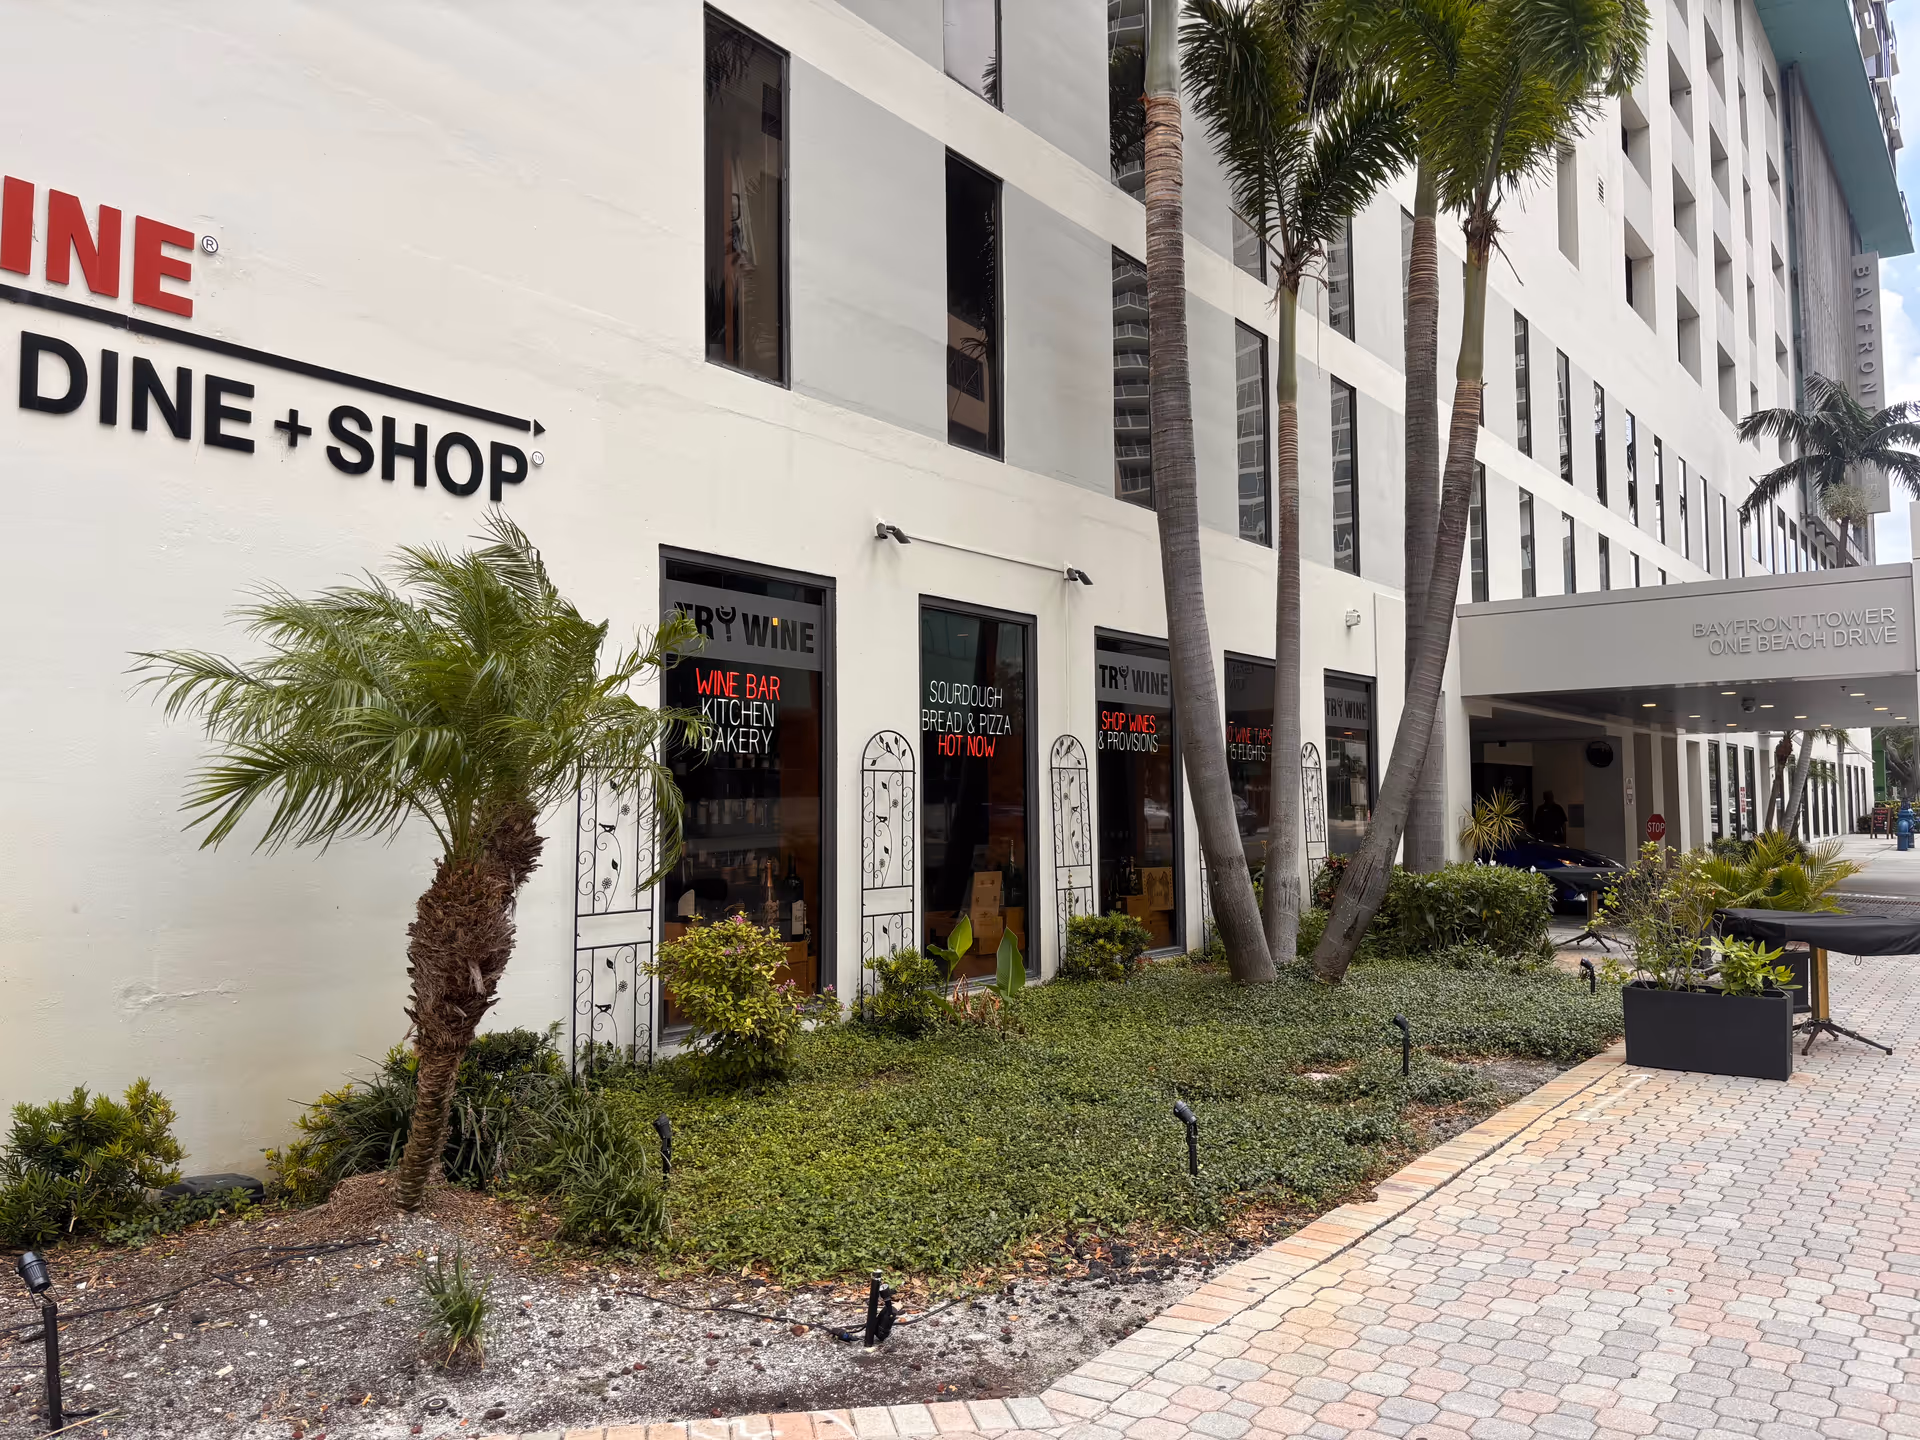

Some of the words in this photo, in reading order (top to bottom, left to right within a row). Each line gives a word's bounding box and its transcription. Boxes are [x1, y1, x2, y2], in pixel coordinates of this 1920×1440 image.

[19, 331, 255, 453] DINE
[326, 405, 528, 502] SHOP
[741, 612, 814, 654] WINE
[1692, 615, 1806, 637] BAYFRONT
[1811, 607, 1896, 629] TOWER
[1709, 636, 1751, 655] ONE
[1757, 632, 1827, 652] BEACH
[1833, 625, 1898, 647] DRIVE
[696, 668, 740, 697] WINE
[746, 672, 781, 700] BAR
[1098, 663, 1129, 691] TRY
[1131, 669, 1169, 696] WINE
[929, 680, 1003, 708] SOURDOUGH
[701, 697, 775, 728] KITCHEN
[922, 709, 963, 733] BREAD
[966, 712, 976, 734] &
[979, 713, 1012, 735] PIZZA
[1102, 710, 1126, 731] SHOP
[1128, 713, 1156, 734] WINES
[1344, 700, 1367, 720] WINE
[701, 725, 774, 754] BAKERY
[938, 734, 963, 756] HOT
[967, 735, 996, 757] NOW
[1098, 730, 1105, 750] &
[1107, 731, 1159, 752] PROVISIONS
[1235, 726, 1252, 744] WINE
[1254, 727, 1272, 745] TAPS
[1238, 744, 1267, 761] FLIGHTS
[1647, 821, 1665, 833] STOP
